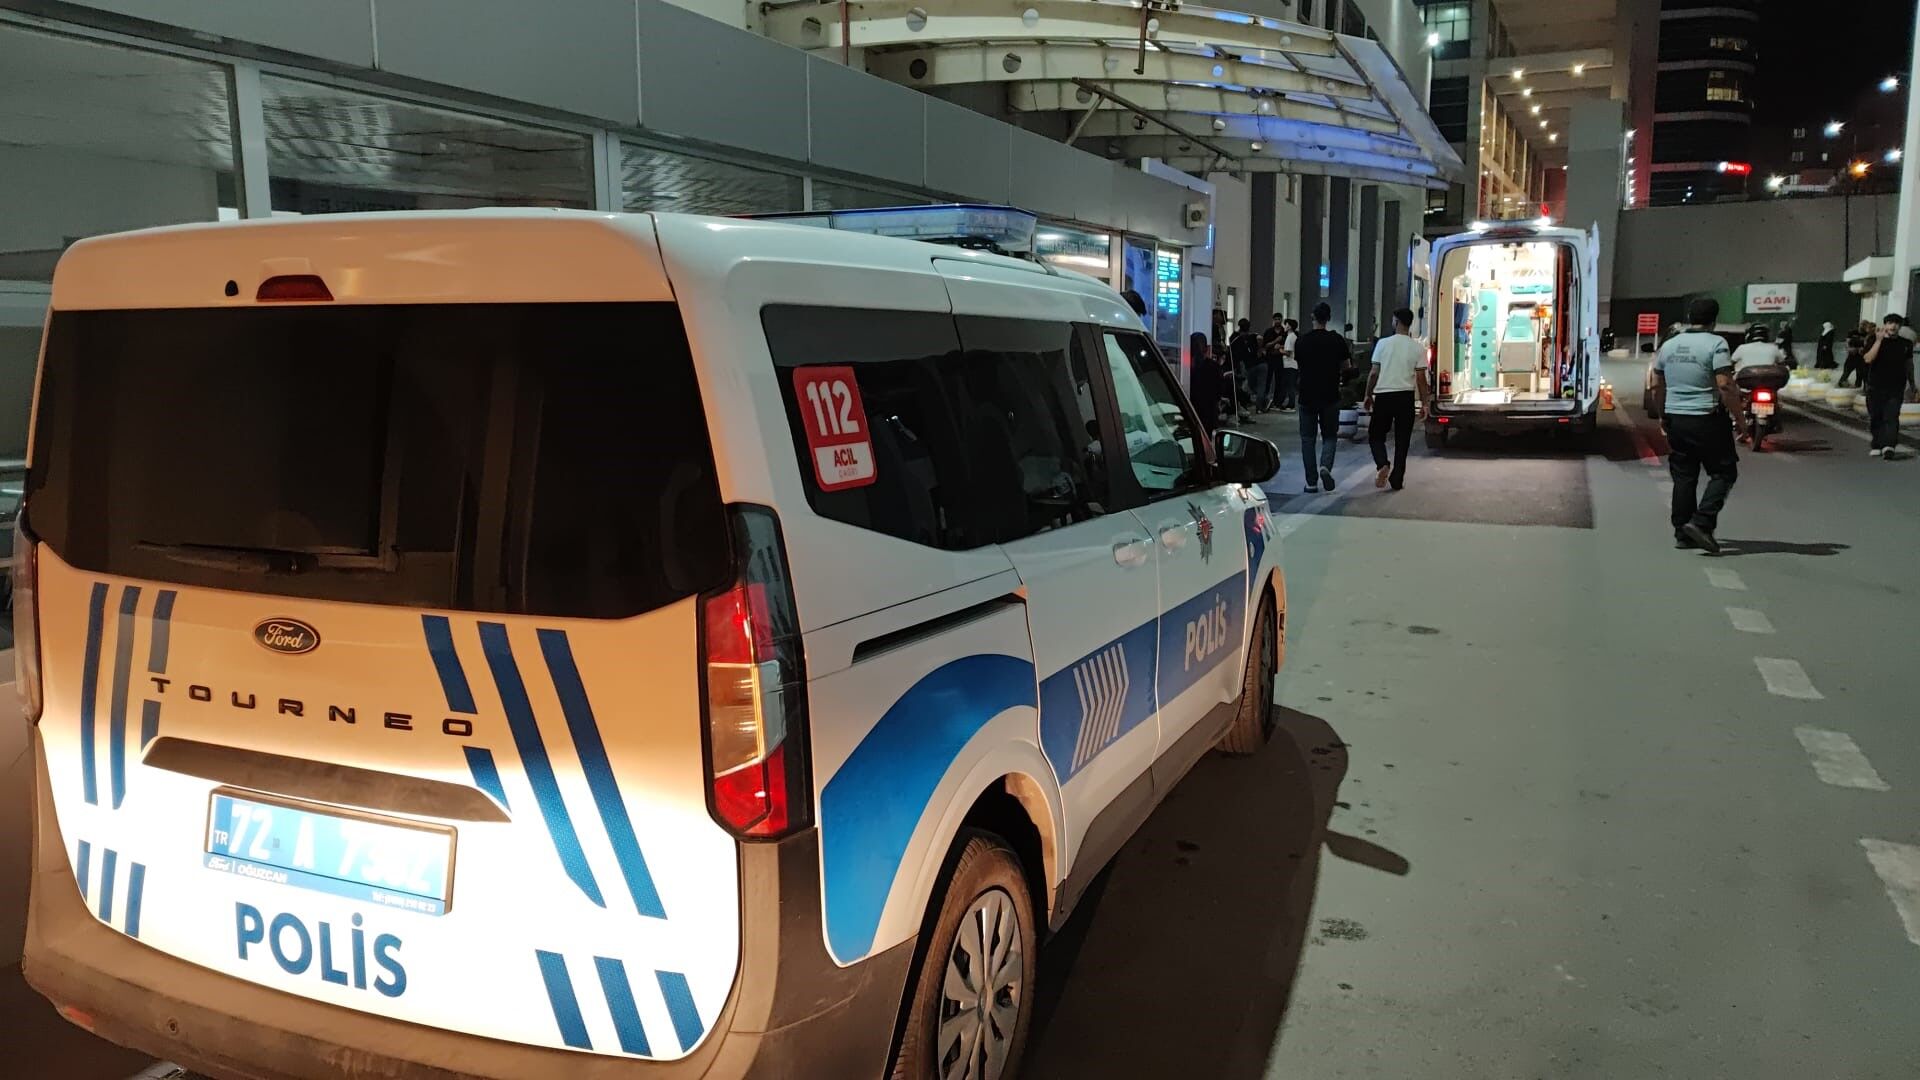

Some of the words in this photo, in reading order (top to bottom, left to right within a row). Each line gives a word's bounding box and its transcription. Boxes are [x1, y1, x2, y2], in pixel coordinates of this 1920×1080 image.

[806, 380, 860, 436] 112
[264, 623, 304, 649] Ford
[1184, 593, 1227, 672] POLİS
[150, 676, 472, 737] TOURNEO
[214, 829, 229, 846] TR
[228, 803, 273, 861] 72
[292, 815, 316, 870] A
[234, 902, 407, 998] POLİS
